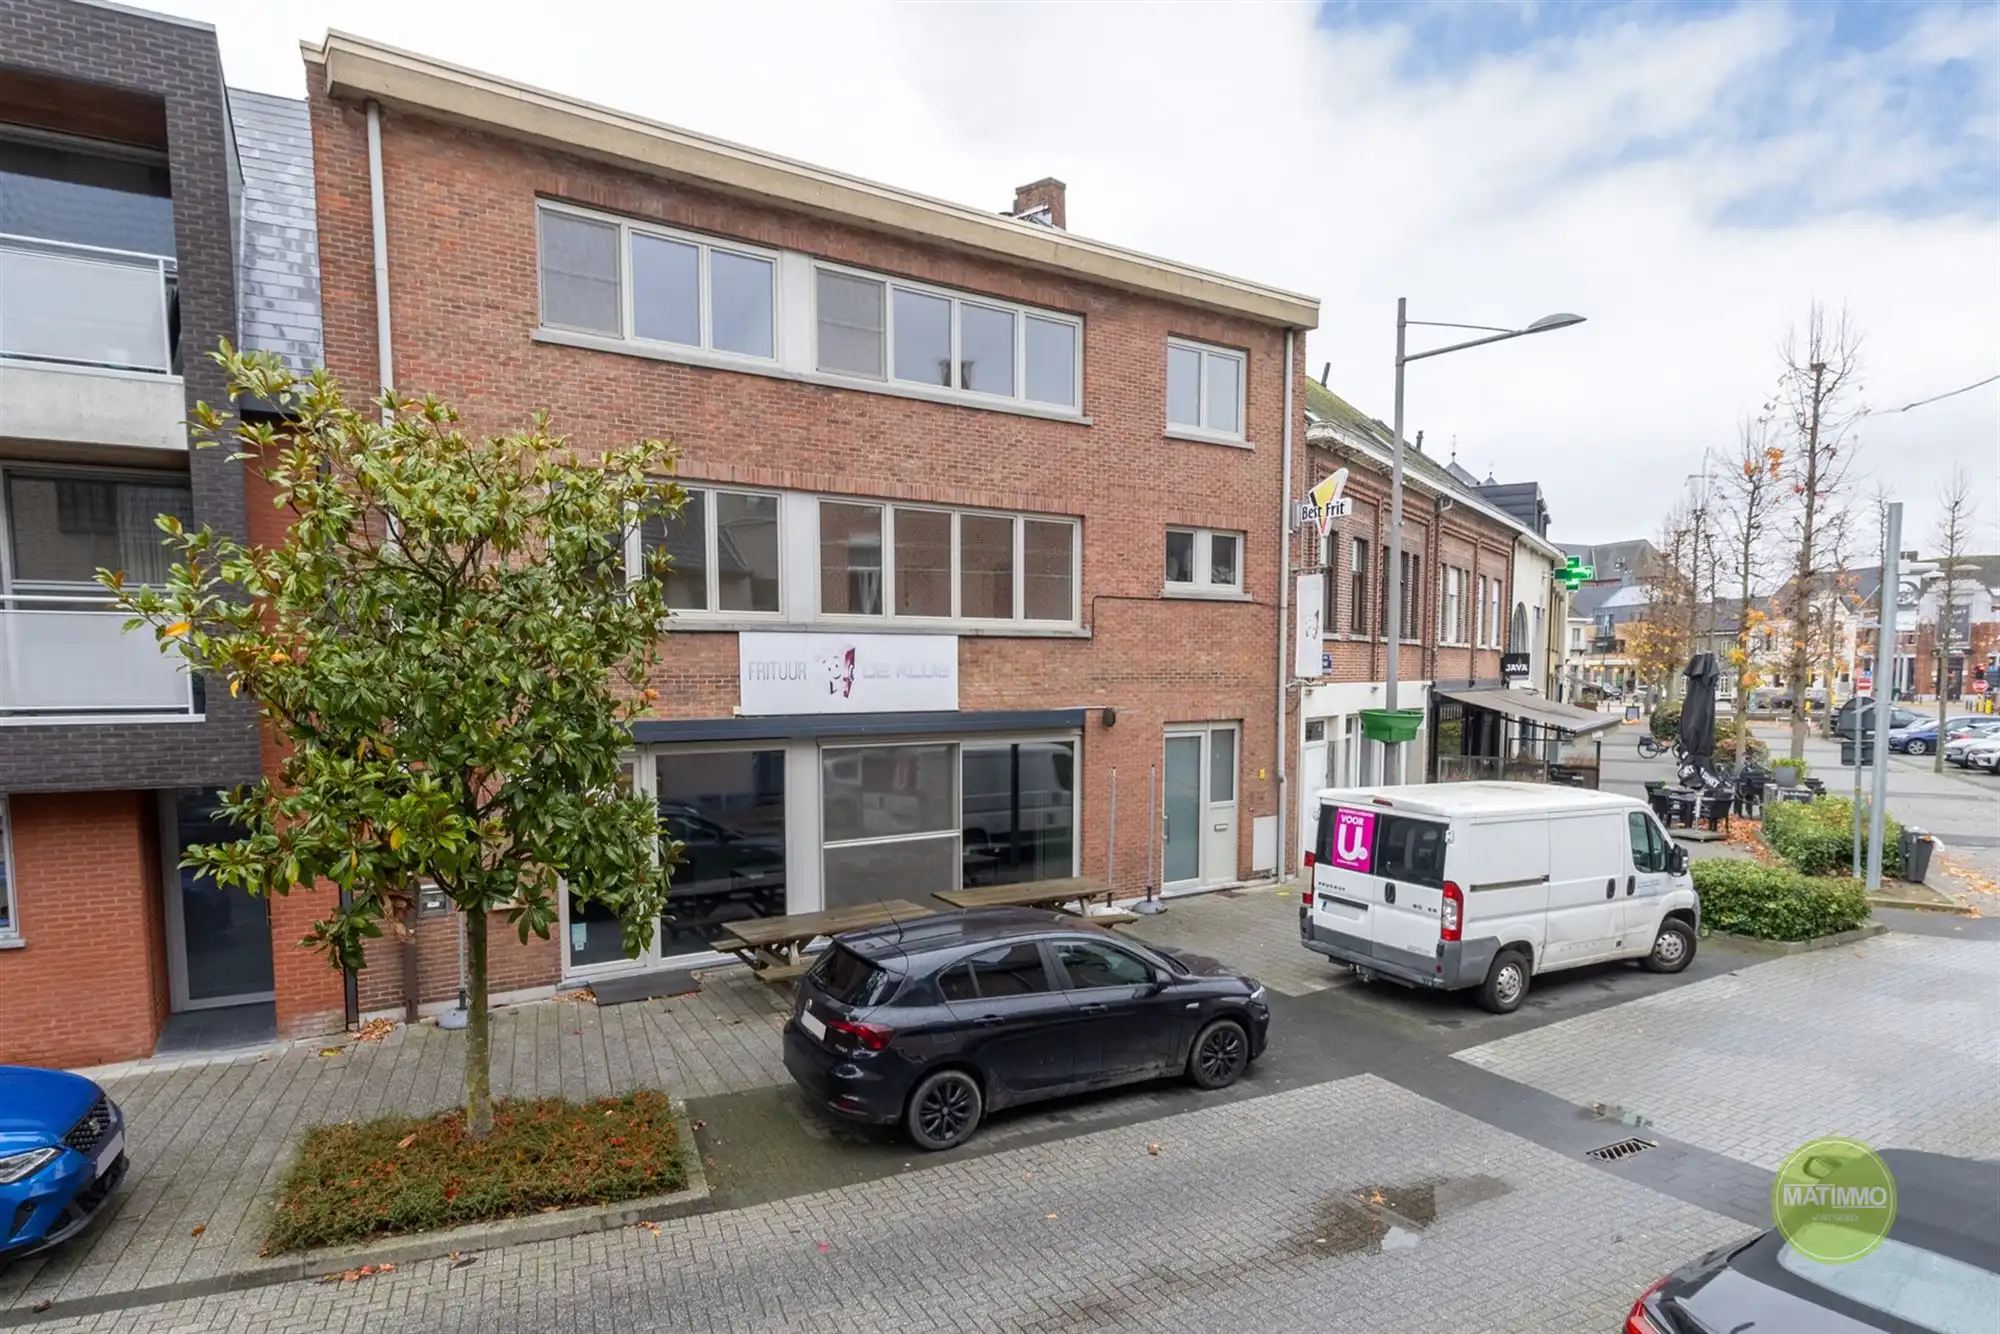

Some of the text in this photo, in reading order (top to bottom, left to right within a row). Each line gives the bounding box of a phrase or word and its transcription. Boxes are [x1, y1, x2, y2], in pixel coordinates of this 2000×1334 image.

[1302, 501, 1345, 521] Best Frit
[749, 661, 807, 681] FRITUUR
[1505, 663, 1528, 672] JAVA
[1341, 813, 1364, 826] VOOR
